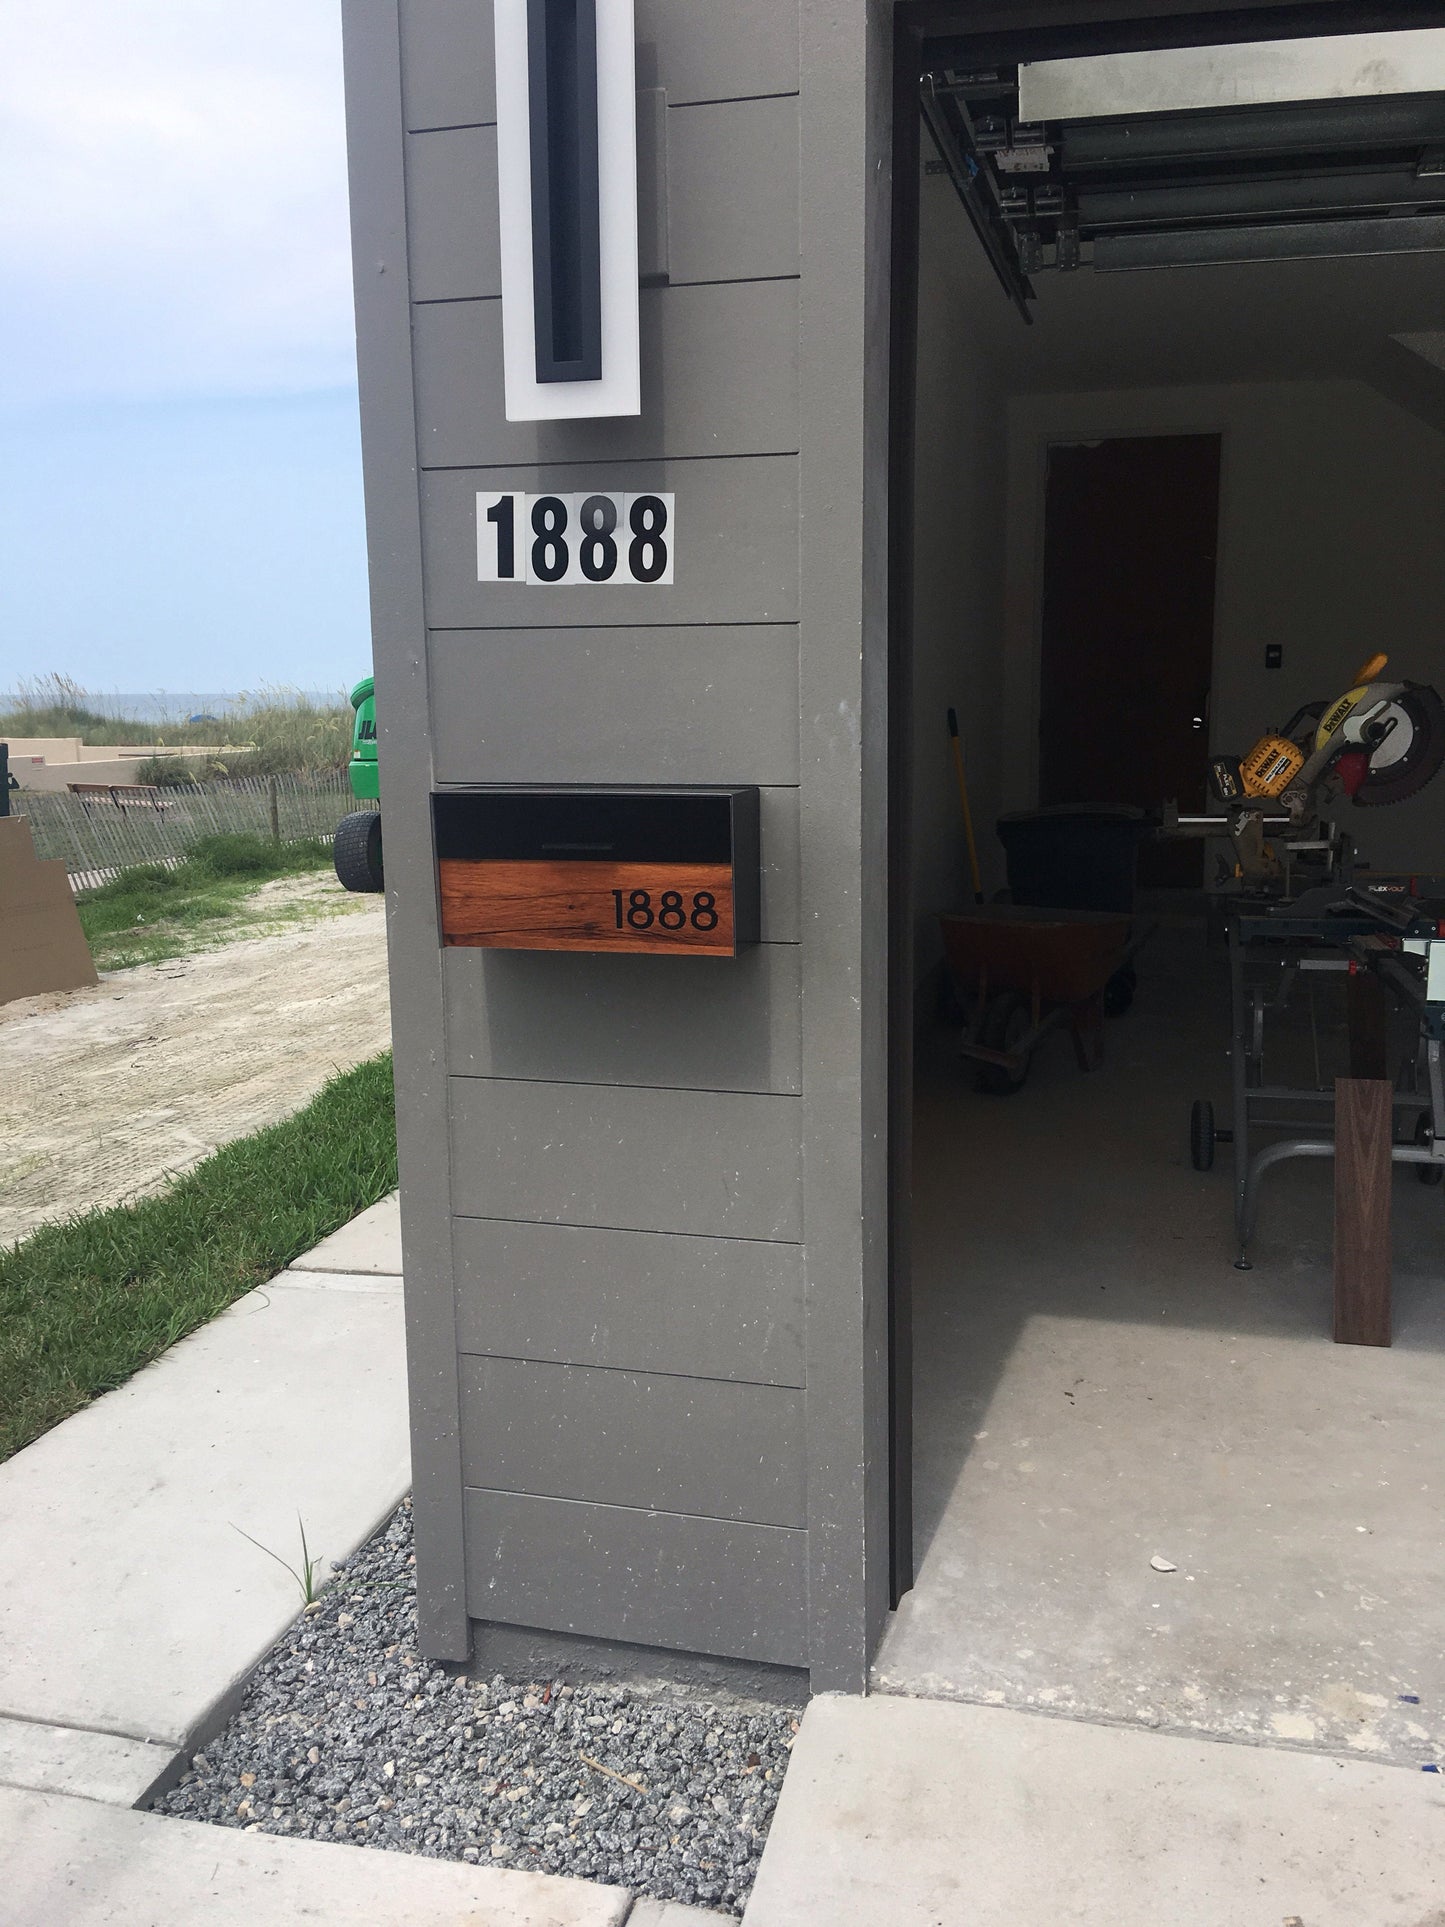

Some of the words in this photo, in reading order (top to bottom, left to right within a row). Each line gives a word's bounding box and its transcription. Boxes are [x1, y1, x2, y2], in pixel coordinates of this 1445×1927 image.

[487, 494, 668, 584] 1888
[358, 720, 377, 739] JL
[611, 889, 719, 932] 1888
